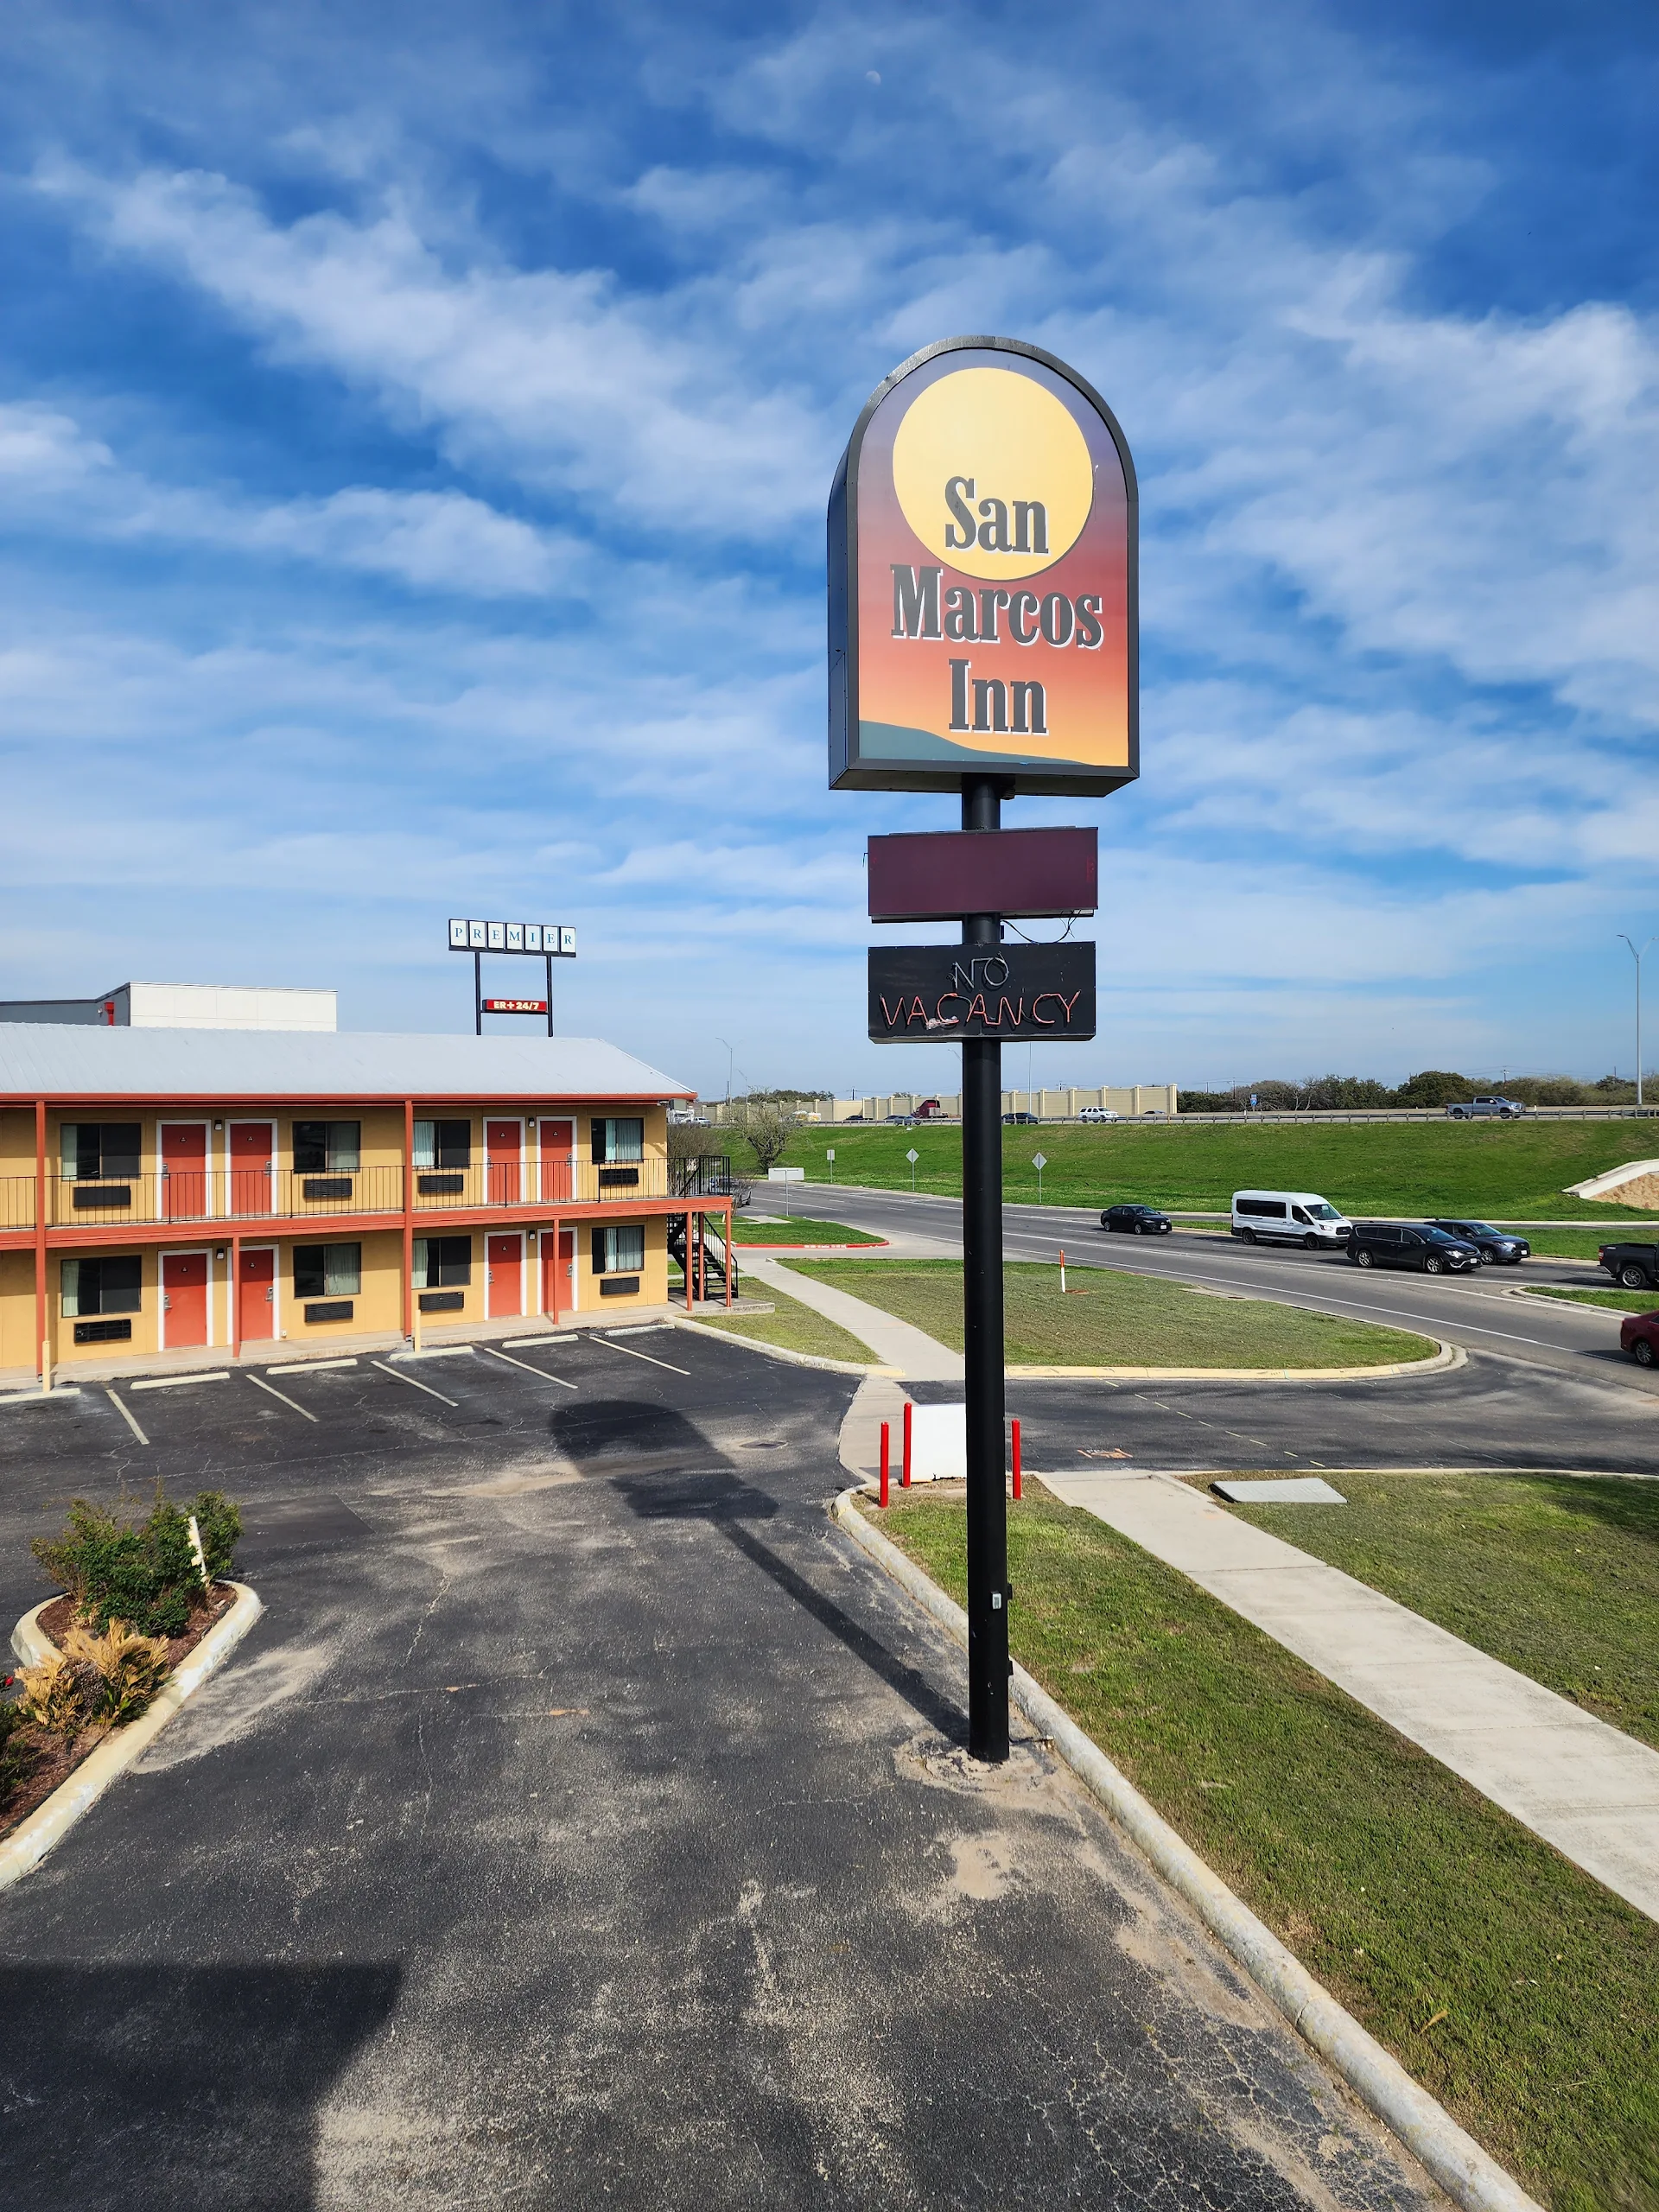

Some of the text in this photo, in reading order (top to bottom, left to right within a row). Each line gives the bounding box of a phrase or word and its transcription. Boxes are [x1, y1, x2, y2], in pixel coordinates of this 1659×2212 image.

[944, 475, 1048, 554] San
[890, 563, 1104, 650] Marcos
[948, 658, 1049, 735] Inn
[454, 927, 573, 944] PREMIER
[952, 957, 1009, 989] NO
[880, 991, 1080, 1027] VACANCY
